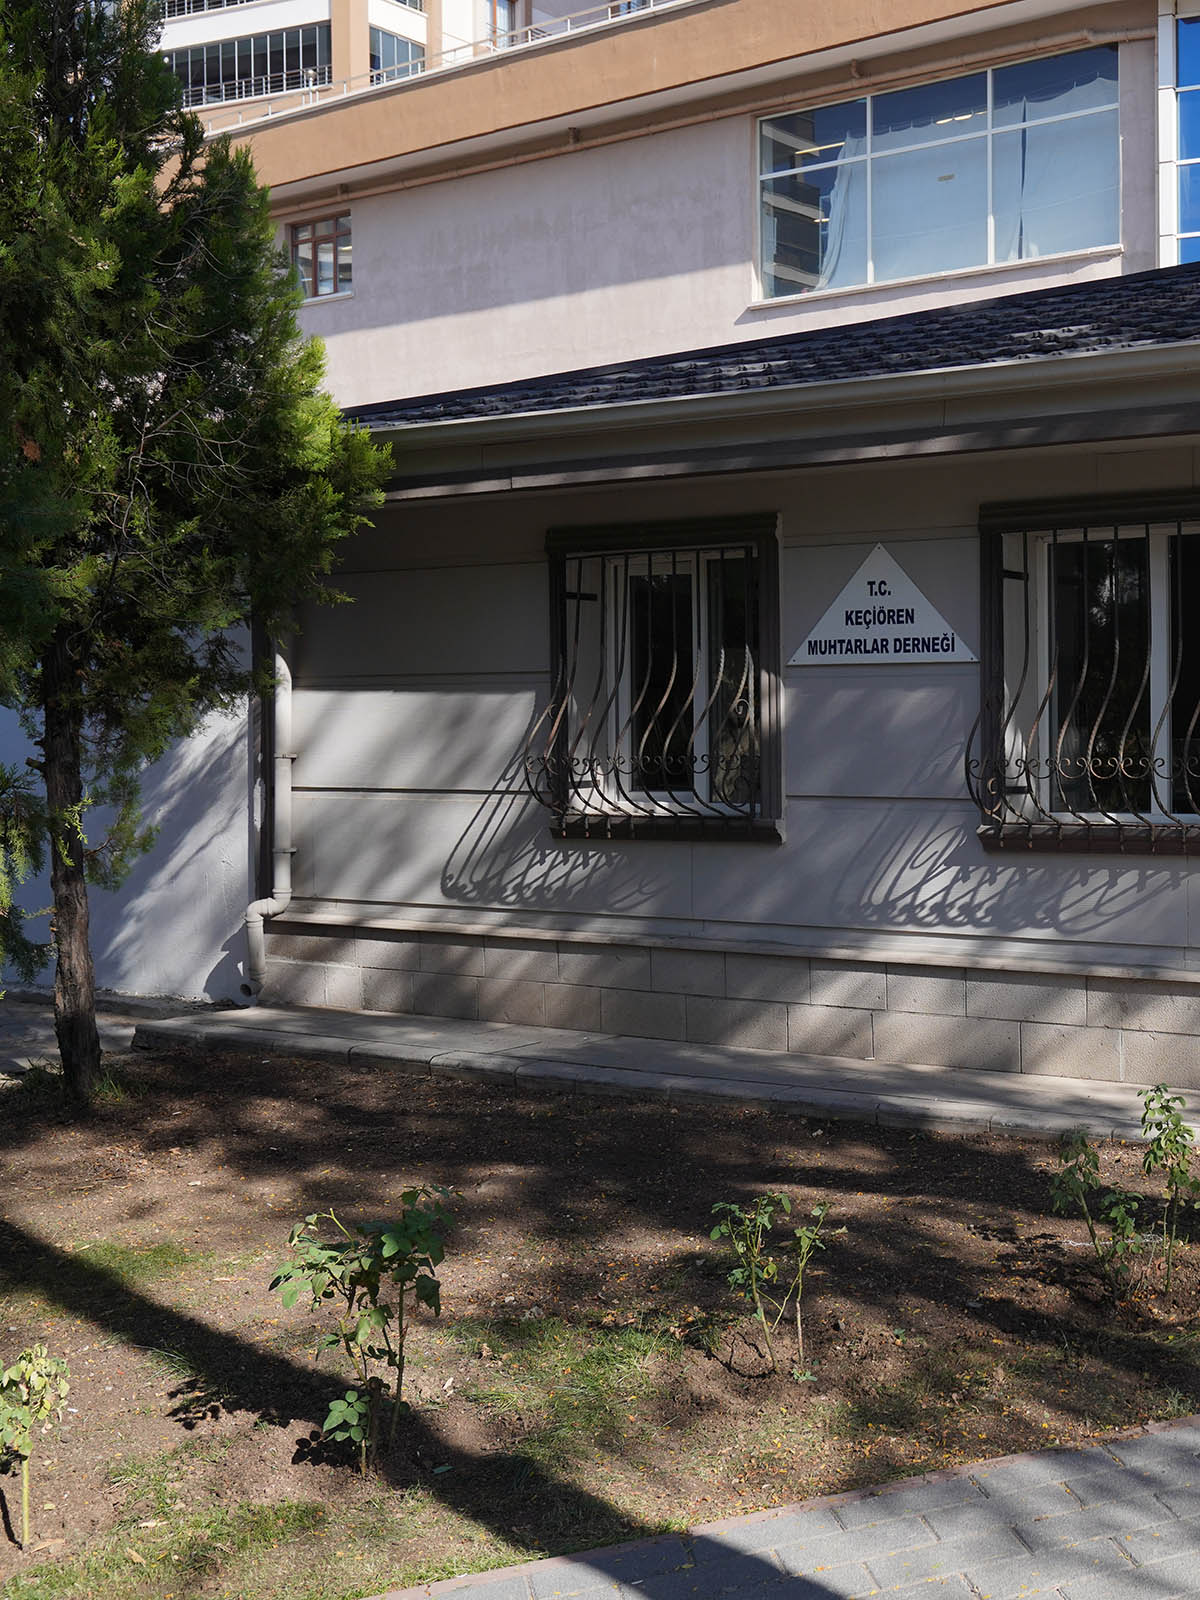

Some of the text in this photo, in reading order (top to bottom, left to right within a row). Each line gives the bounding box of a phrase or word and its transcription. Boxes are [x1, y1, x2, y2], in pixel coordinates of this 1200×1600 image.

[867, 580, 892, 596] T.C.
[845, 606, 915, 629] KEÇİÖREN
[807, 633, 956, 655] MUHTARLAR DERNEĞİ
